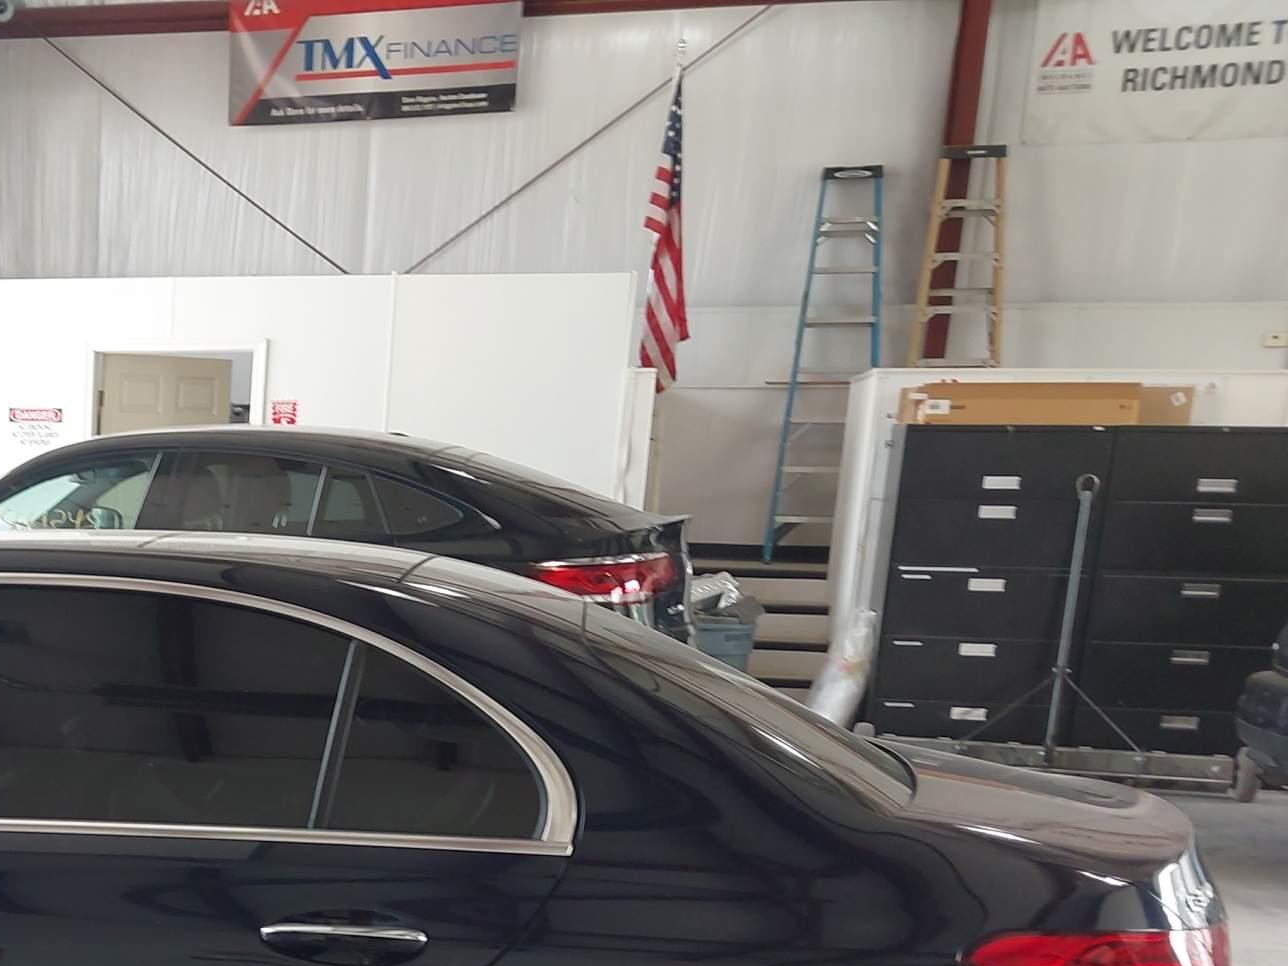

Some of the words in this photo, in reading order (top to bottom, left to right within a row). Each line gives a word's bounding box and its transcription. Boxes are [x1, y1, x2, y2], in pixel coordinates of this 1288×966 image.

[1111, 21, 1263, 54] WELCOME
[296, 35, 392, 80] TMX
[385, 34, 520, 60] FINANCE
[1120, 59, 1286, 93] RICHMOND
